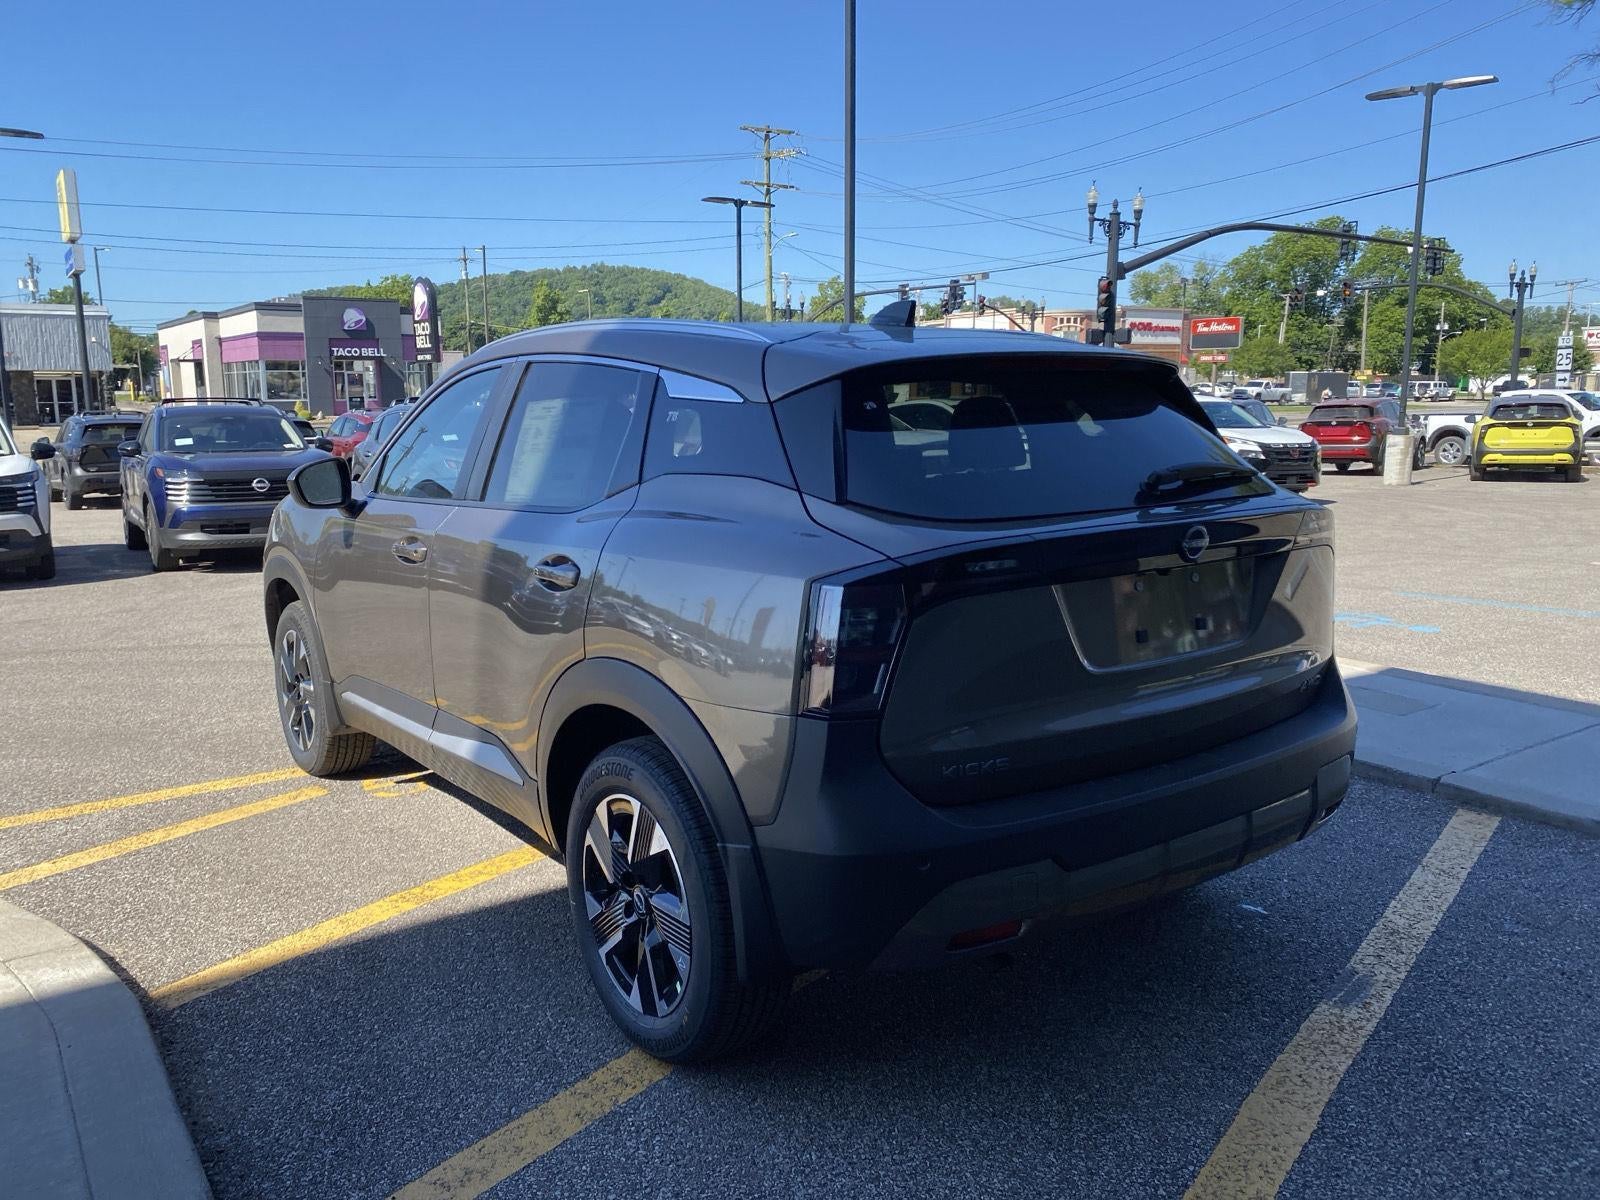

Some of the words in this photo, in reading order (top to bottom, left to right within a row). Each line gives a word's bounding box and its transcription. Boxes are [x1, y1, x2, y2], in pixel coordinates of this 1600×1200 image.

[414, 322, 430, 335] TACO
[1197, 322, 1210, 333] Tim
[1210, 321, 1236, 332] Hortons
[416, 335, 432, 348] BELL
[331, 347, 360, 357] TACO
[361, 347, 387, 357] BELL
[1557, 352, 1572, 366] 25
